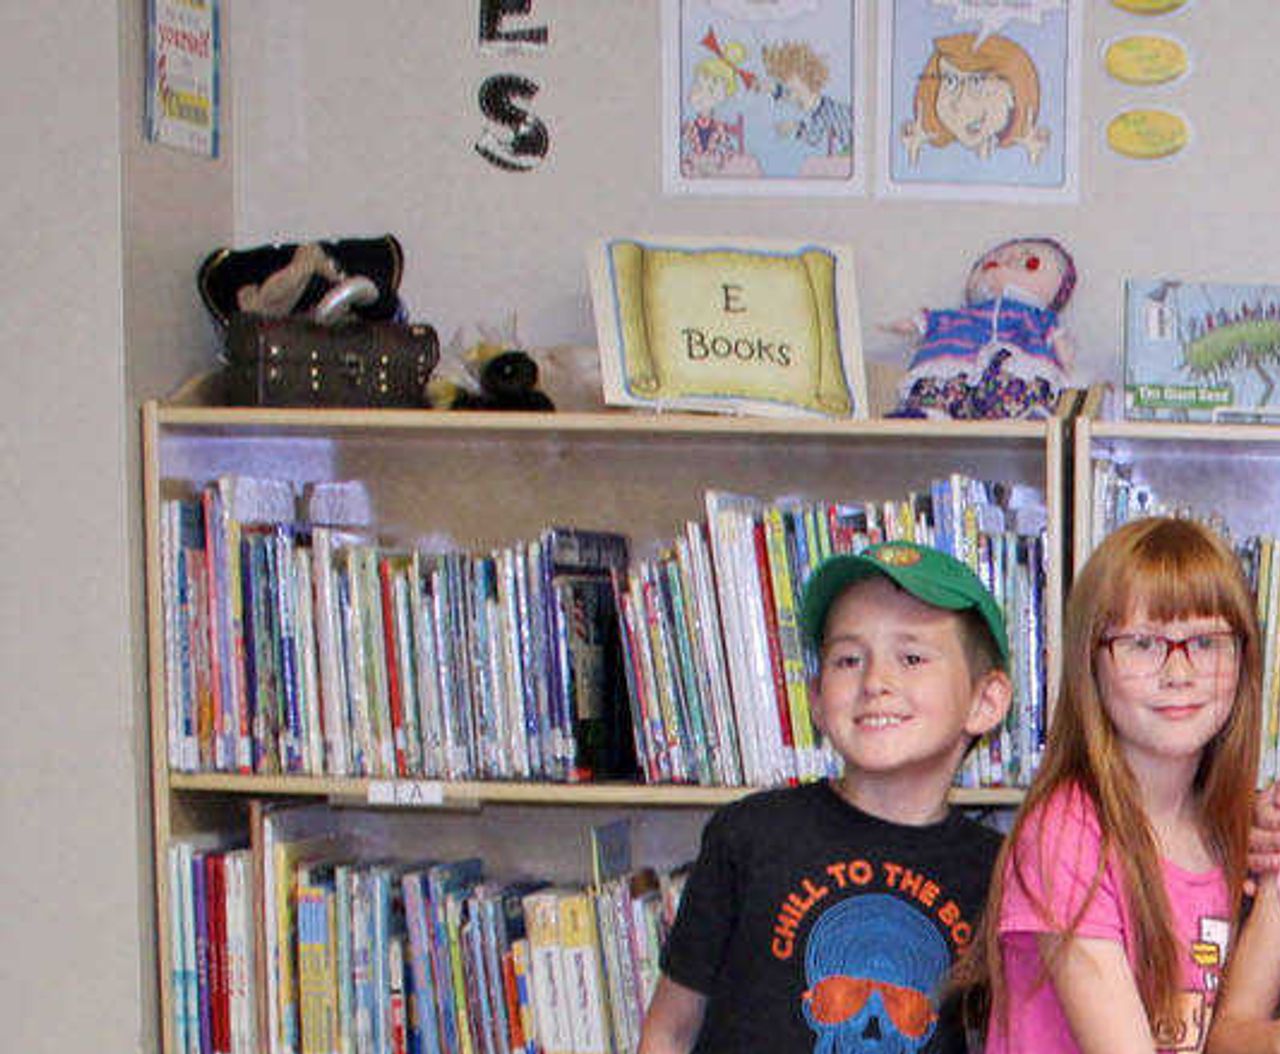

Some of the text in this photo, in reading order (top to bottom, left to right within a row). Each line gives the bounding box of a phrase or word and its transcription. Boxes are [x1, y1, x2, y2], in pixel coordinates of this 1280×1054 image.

[722, 284, 746, 314] E
[682, 328, 793, 368] Books
[771, 858, 975, 960] CHILL TO THE BO
